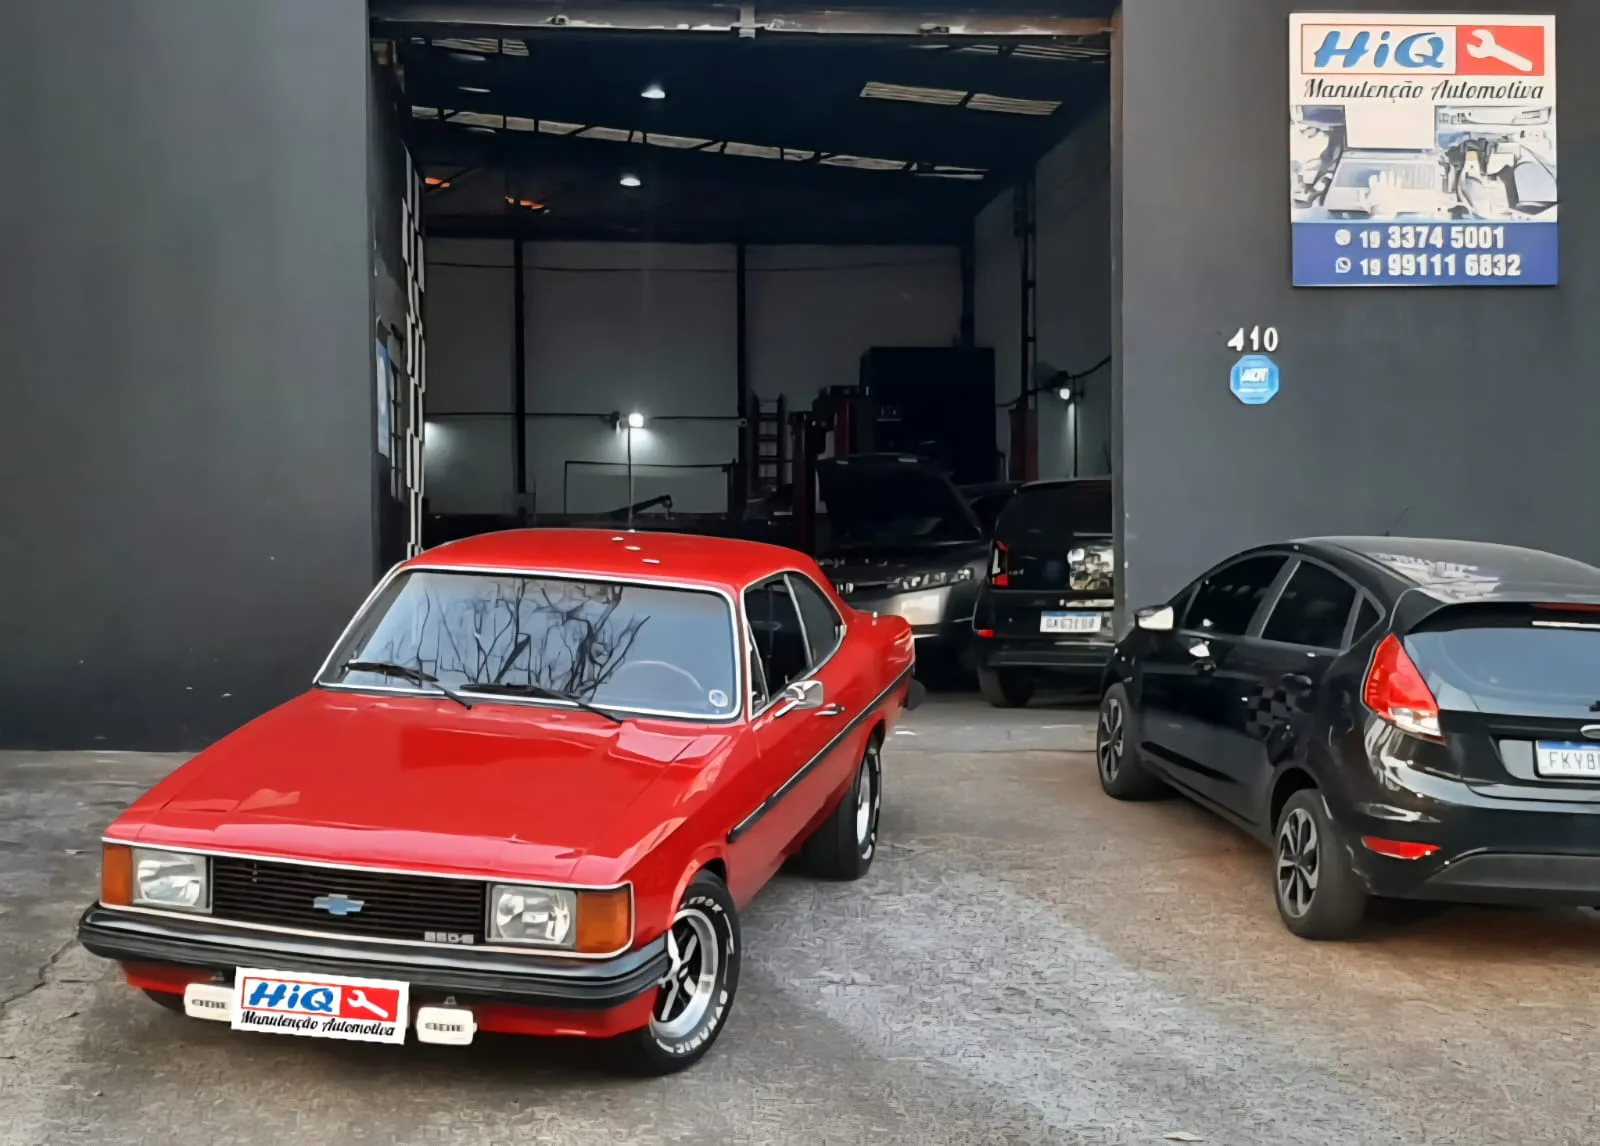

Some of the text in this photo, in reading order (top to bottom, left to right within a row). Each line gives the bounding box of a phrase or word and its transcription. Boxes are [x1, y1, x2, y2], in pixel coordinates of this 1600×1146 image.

[1314, 30, 1445, 69] HiQ
[1303, 79, 1544, 103] Manutenção Automotiva
[1387, 226, 1444, 249] 3374
[1451, 226, 1505, 249] 5001
[1360, 258, 1381, 276] 19
[1388, 254, 1456, 276] 99111
[1227, 325, 1278, 351] 410
